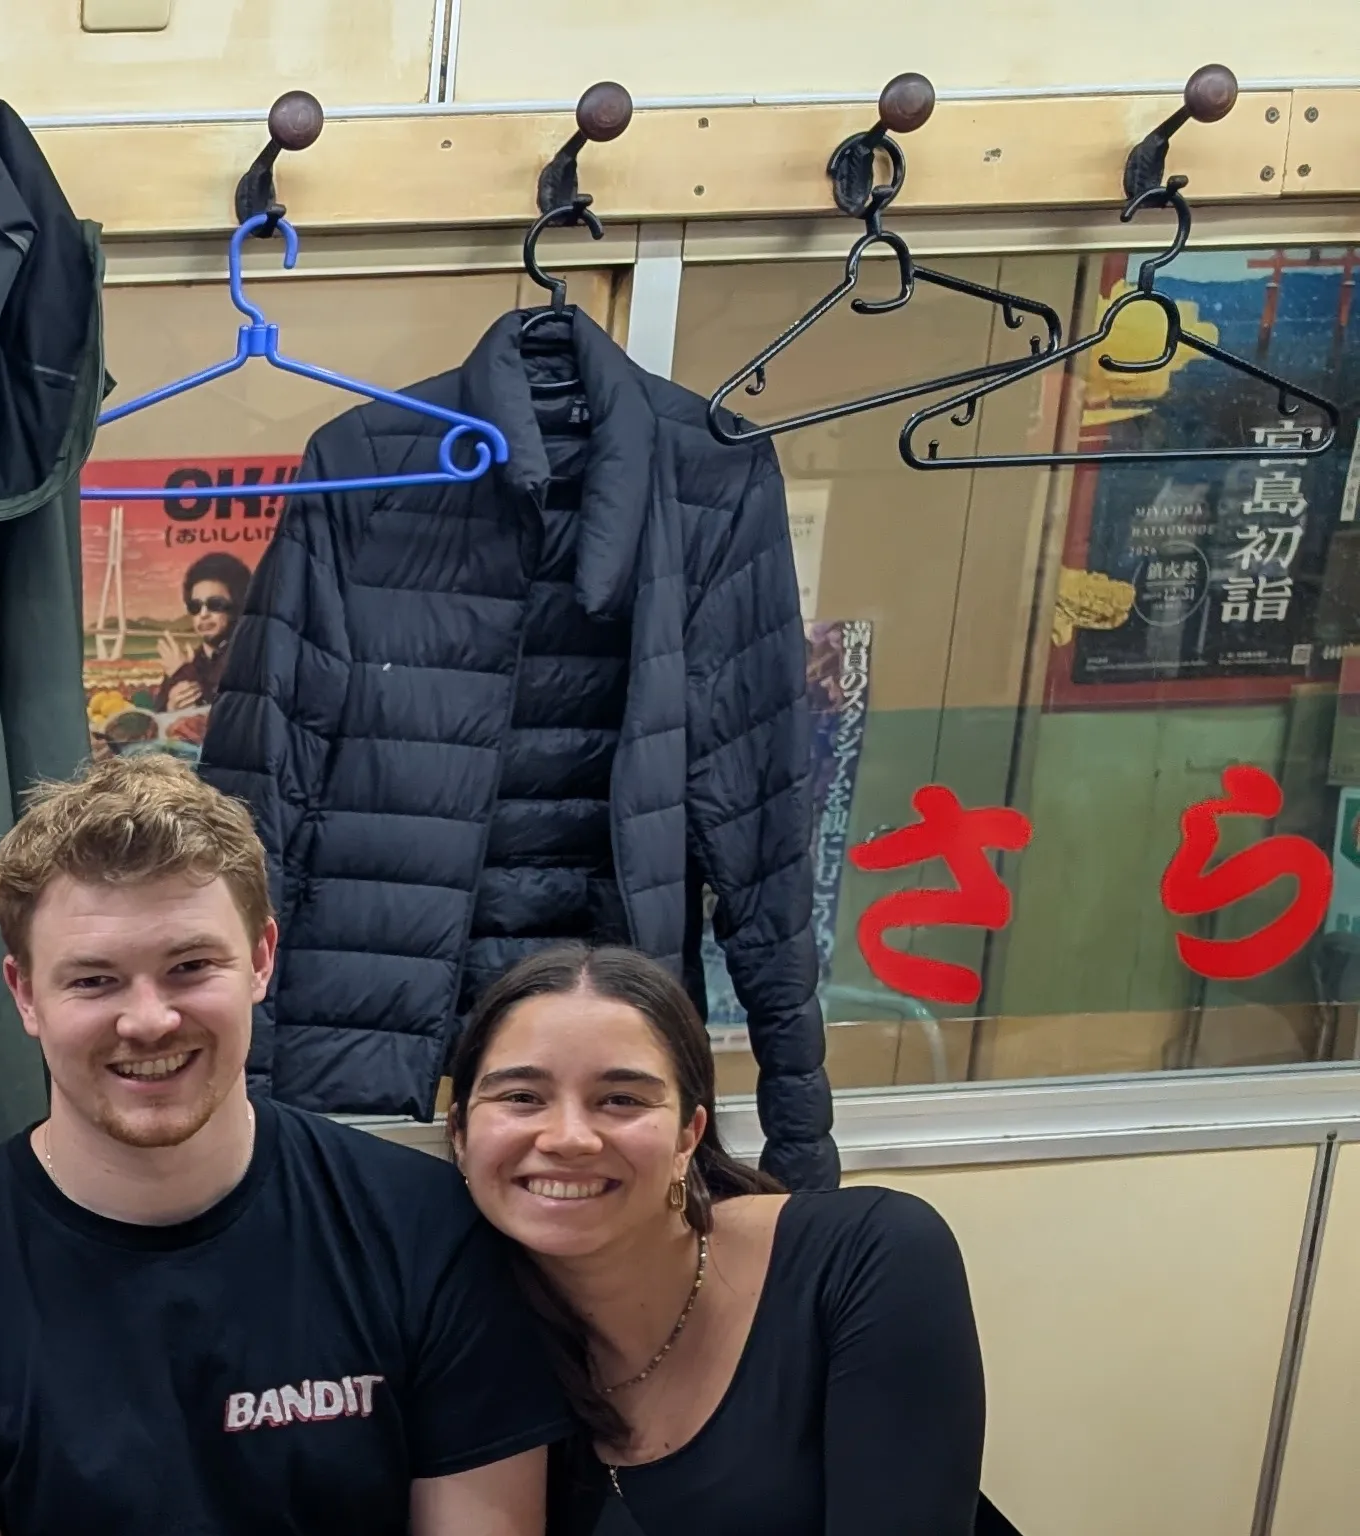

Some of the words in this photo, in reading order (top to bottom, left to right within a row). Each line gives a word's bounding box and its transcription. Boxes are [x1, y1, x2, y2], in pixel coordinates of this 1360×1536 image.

[1220, 420, 1322, 623] 宮島初詣
[224, 1375, 384, 1432] BANDIT
